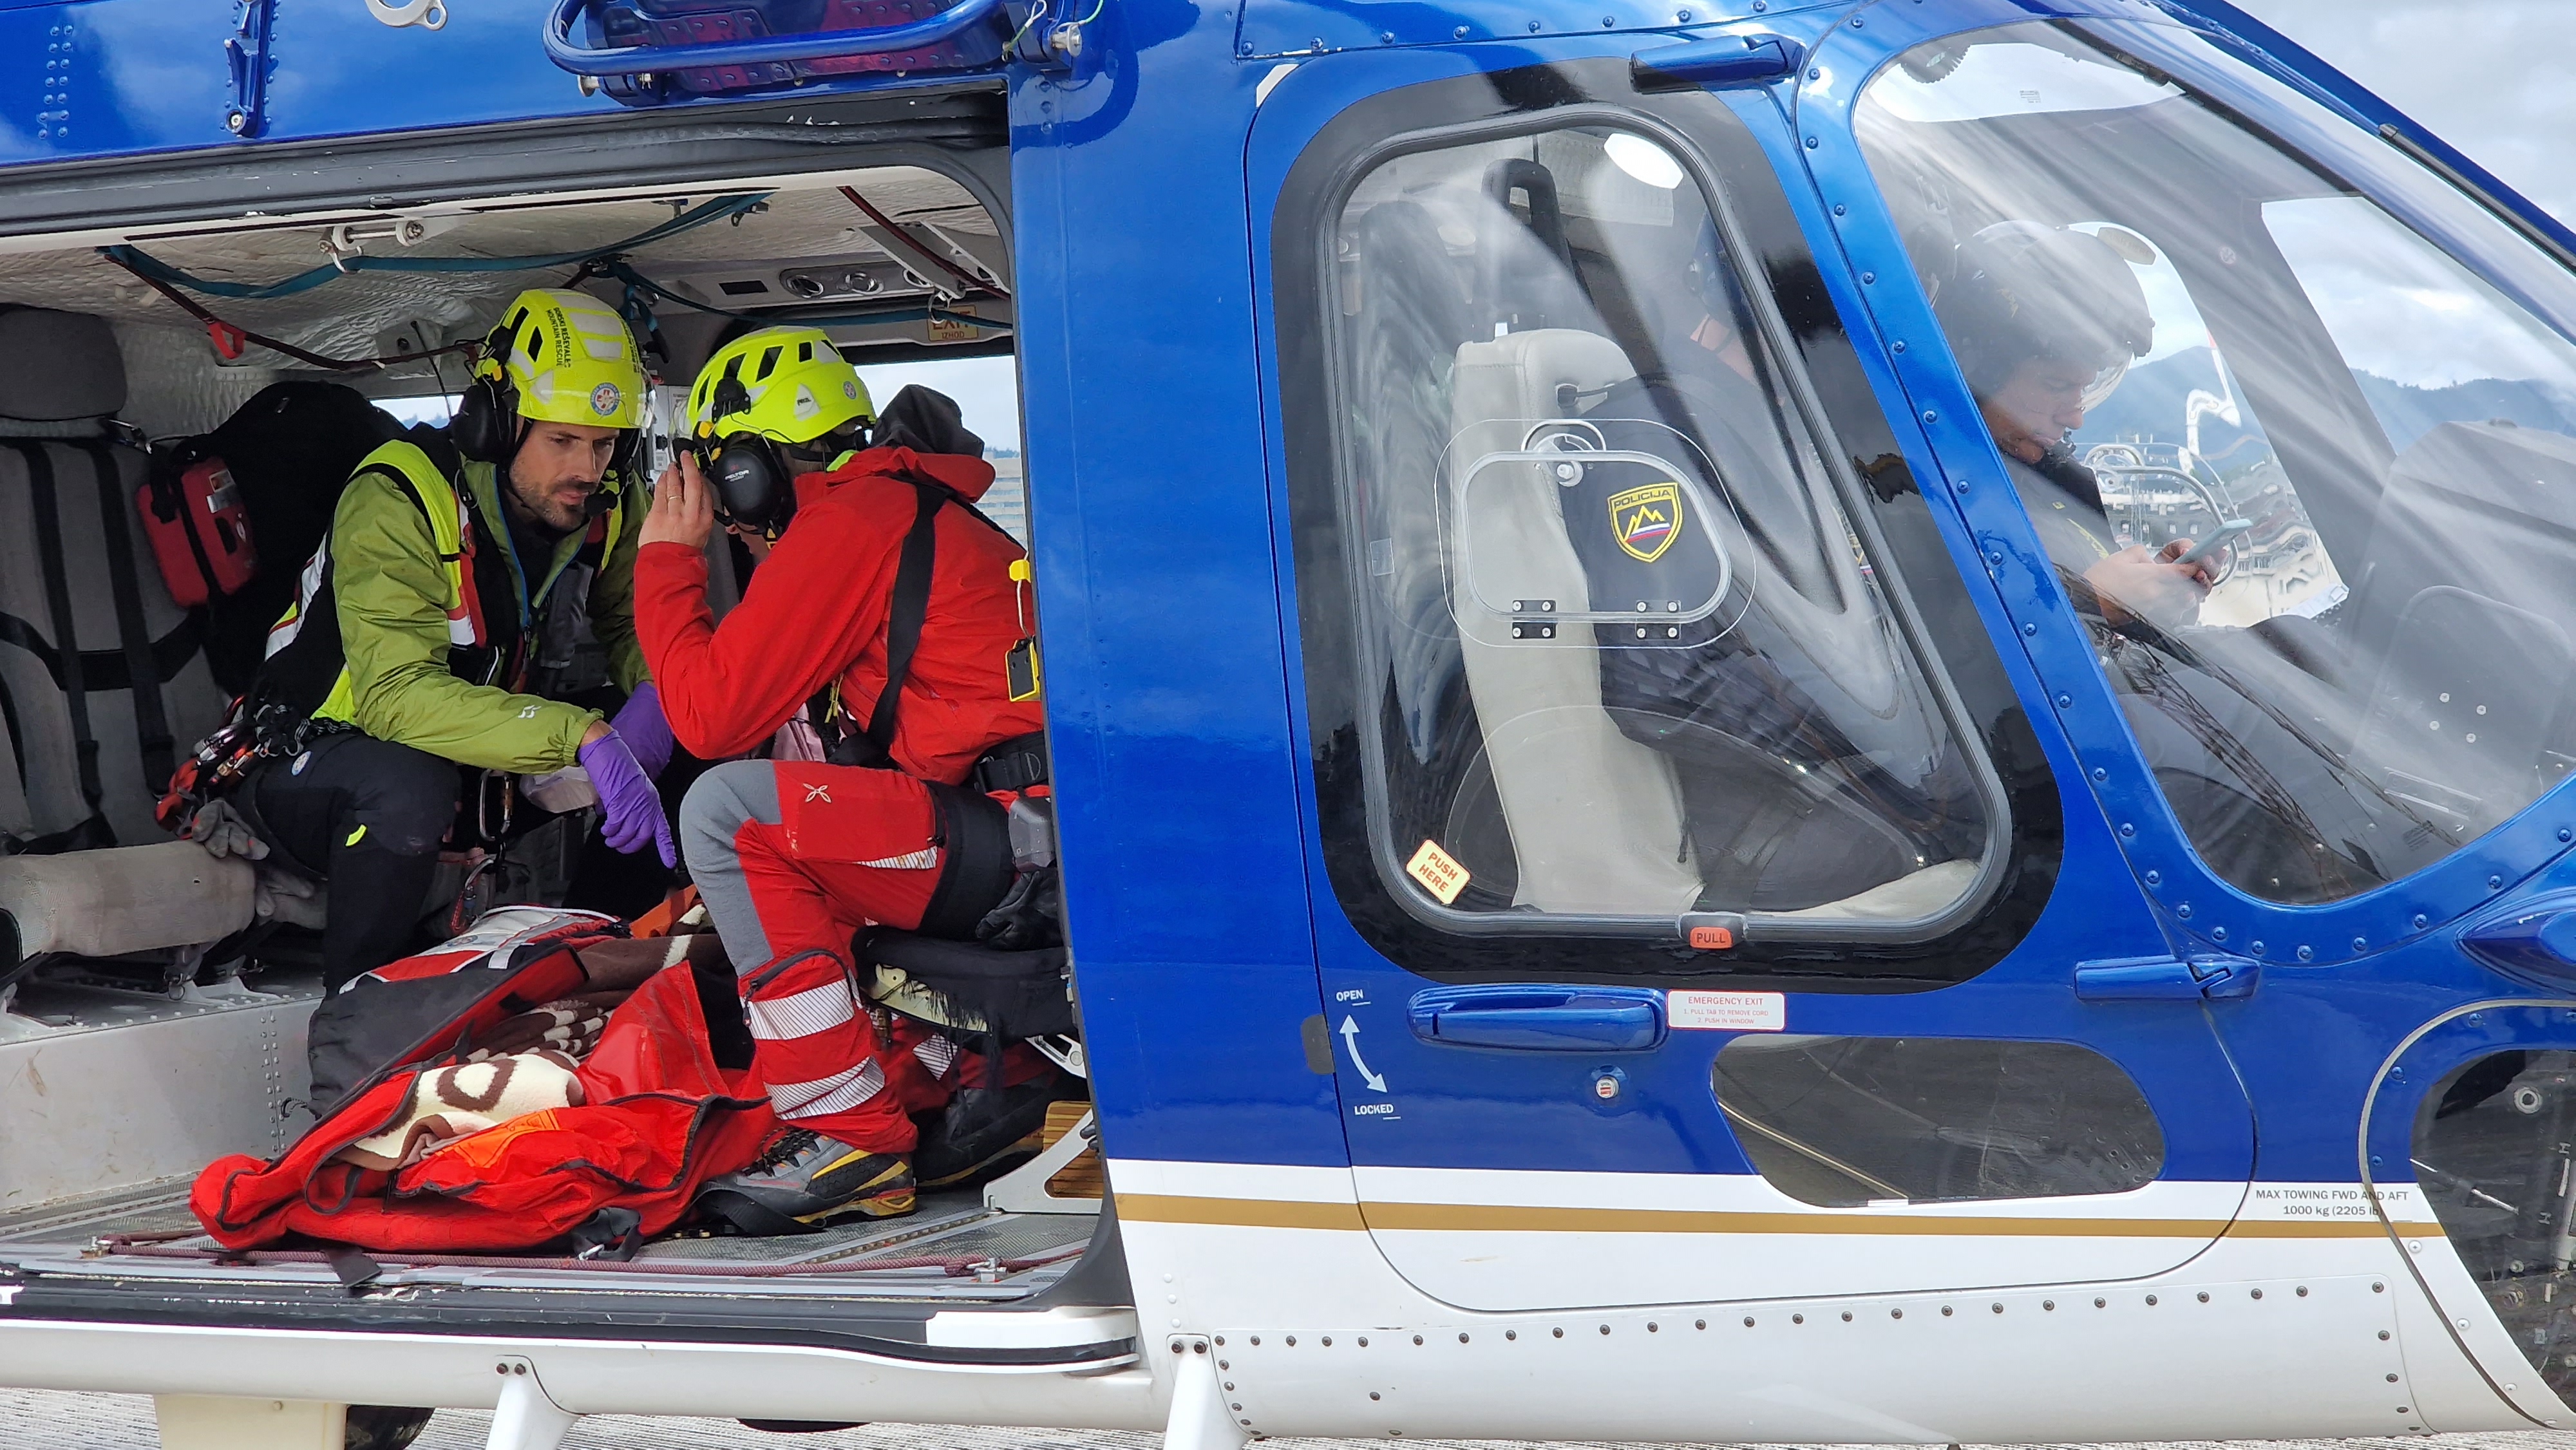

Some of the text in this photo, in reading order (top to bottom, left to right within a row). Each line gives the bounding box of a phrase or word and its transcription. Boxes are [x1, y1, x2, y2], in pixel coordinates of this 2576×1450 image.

[553, 307, 566, 327] GORSKI
[545, 309, 561, 339] MOUNTAIN
[1614, 490, 1671, 507] POLICIJA
[1428, 851, 1459, 881] PUSH
[1418, 863, 1449, 893] HERE
[1696, 932, 1726, 943] PULL
[1336, 989, 1364, 1001] OPEN
[1688, 996, 1742, 1005] EMERGENCY
[1354, 1104, 1394, 1115] LOCKED
[2256, 1190, 2409, 1201] MAX TOWING FWD AND AFT
[2283, 1205, 2313, 1215] 1000
[2316, 1205, 2329, 1217] kg
[2332, 1205, 2366, 1217] (2205
